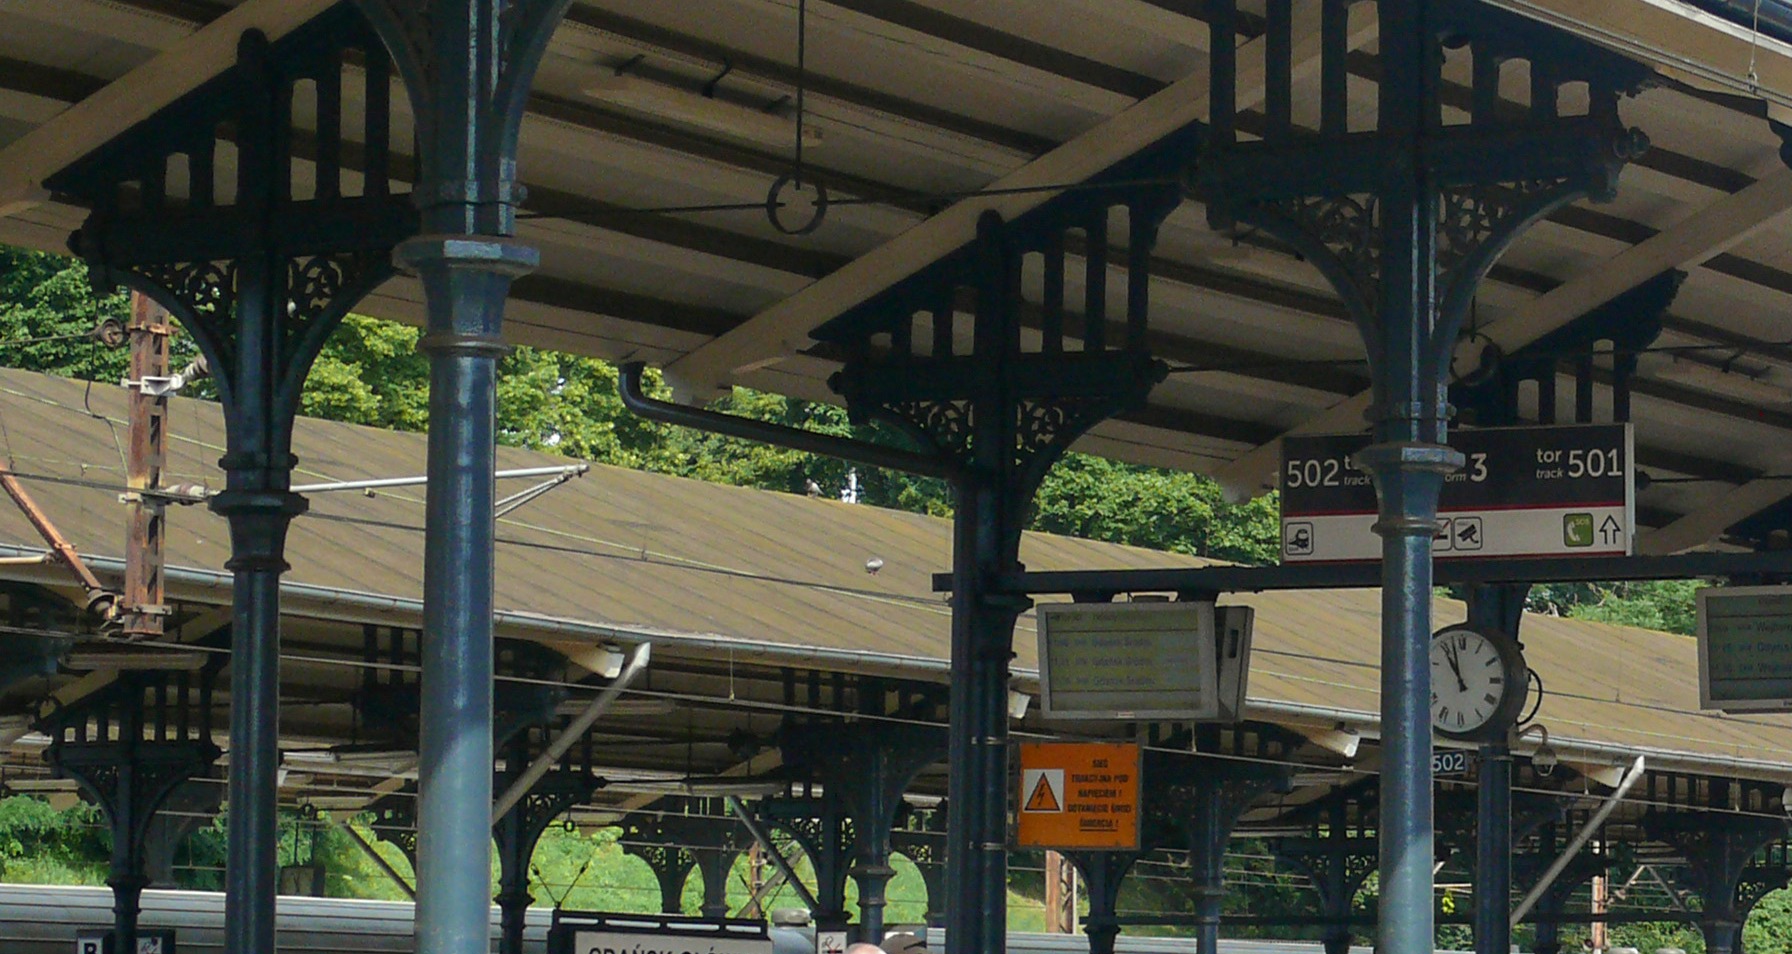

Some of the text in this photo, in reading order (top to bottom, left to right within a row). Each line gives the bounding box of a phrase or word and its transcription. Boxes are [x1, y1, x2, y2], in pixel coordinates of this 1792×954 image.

[1287, 459, 1340, 488] 502
[1470, 452, 1488, 482] 3
[1536, 448, 1623, 478] tor 501
[1536, 467, 1564, 479] track
[1343, 475, 1372, 486] track
